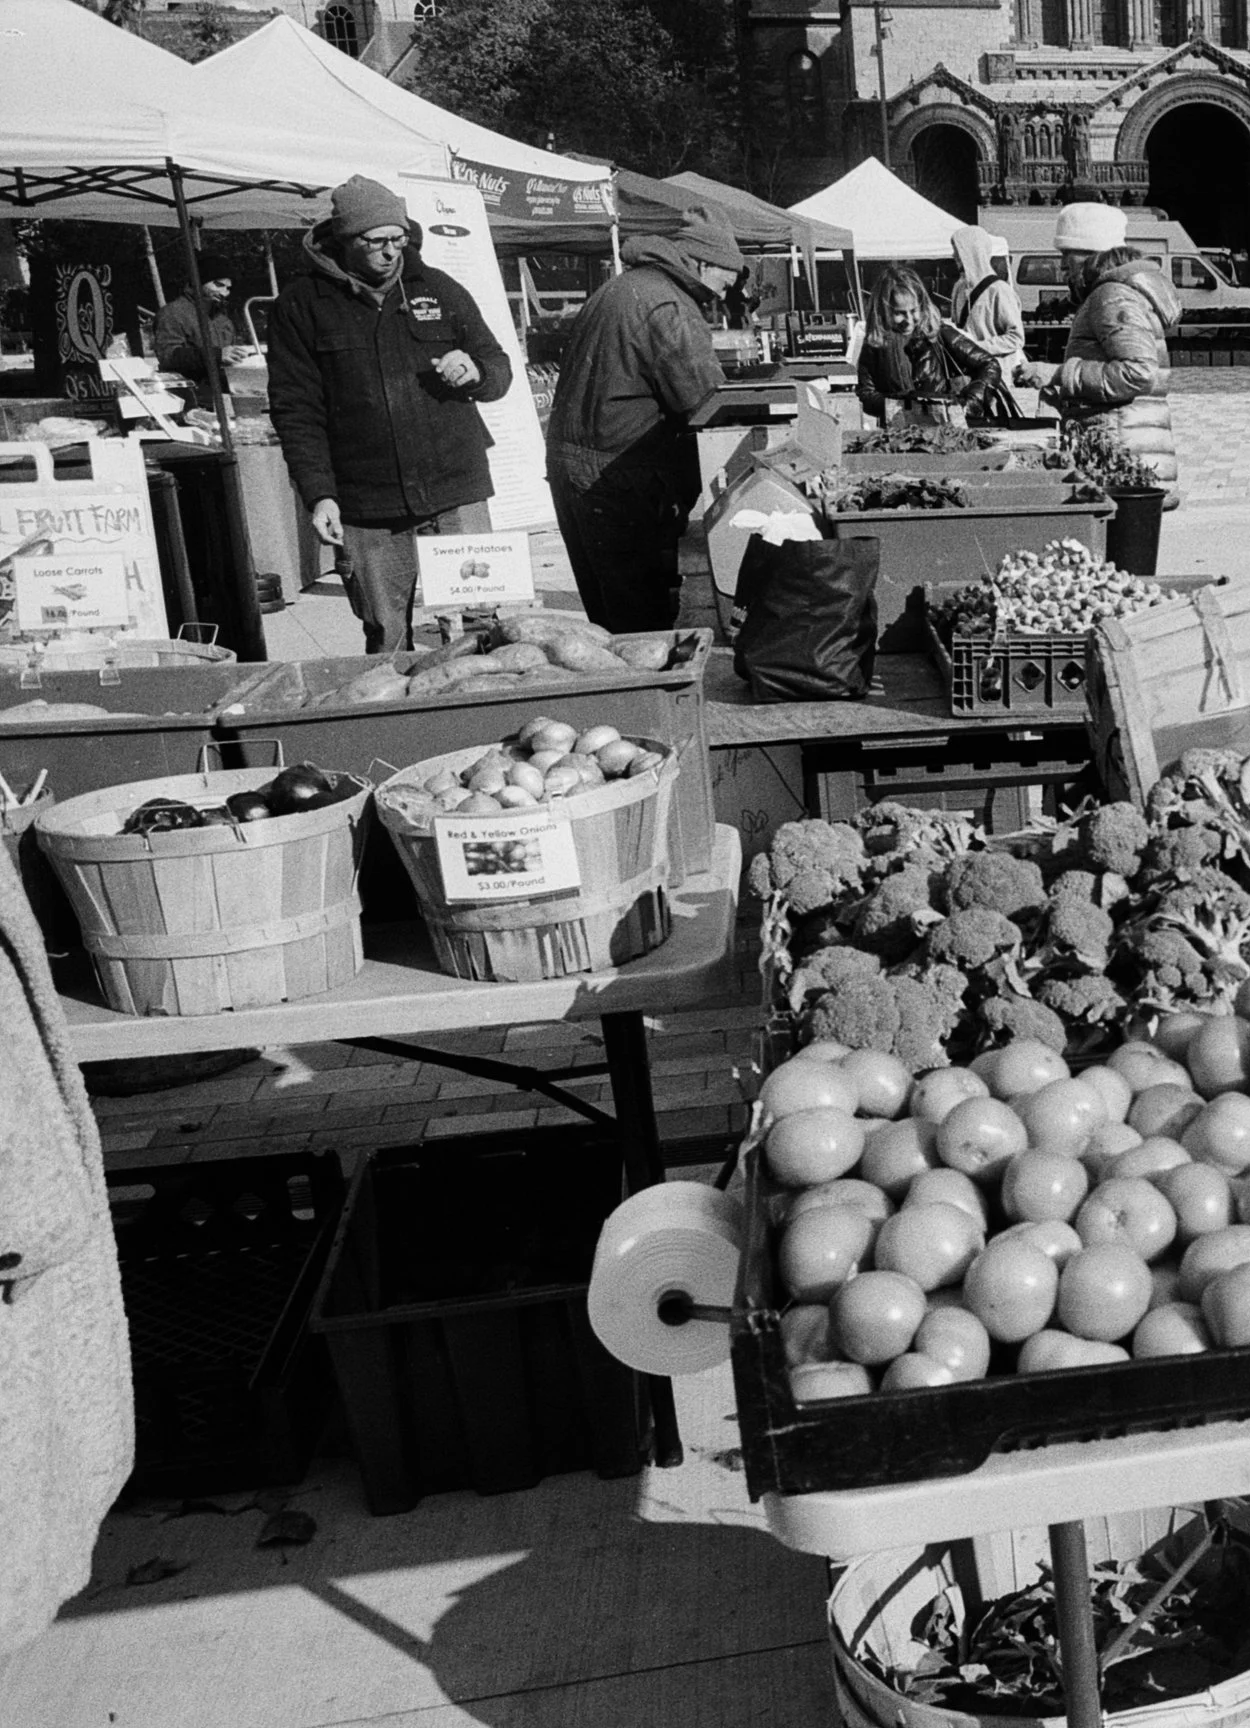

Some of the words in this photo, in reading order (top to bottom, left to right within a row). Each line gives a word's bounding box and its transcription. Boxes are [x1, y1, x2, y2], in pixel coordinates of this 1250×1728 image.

[479, 171, 511, 194] Nuts
[16, 508, 85, 536] FRUIT
[88, 504, 142, 535] FARM
[432, 547, 465, 556] Sweet
[467, 544, 513, 554] Potatoes
[33, 567, 63, 578] Loose
[66, 566, 104, 576] Carrots
[447, 830, 467, 839] Red
[471, 830, 477, 839] &
[481, 829, 517, 839] Yellow
[520, 823, 558, 836] Onions
